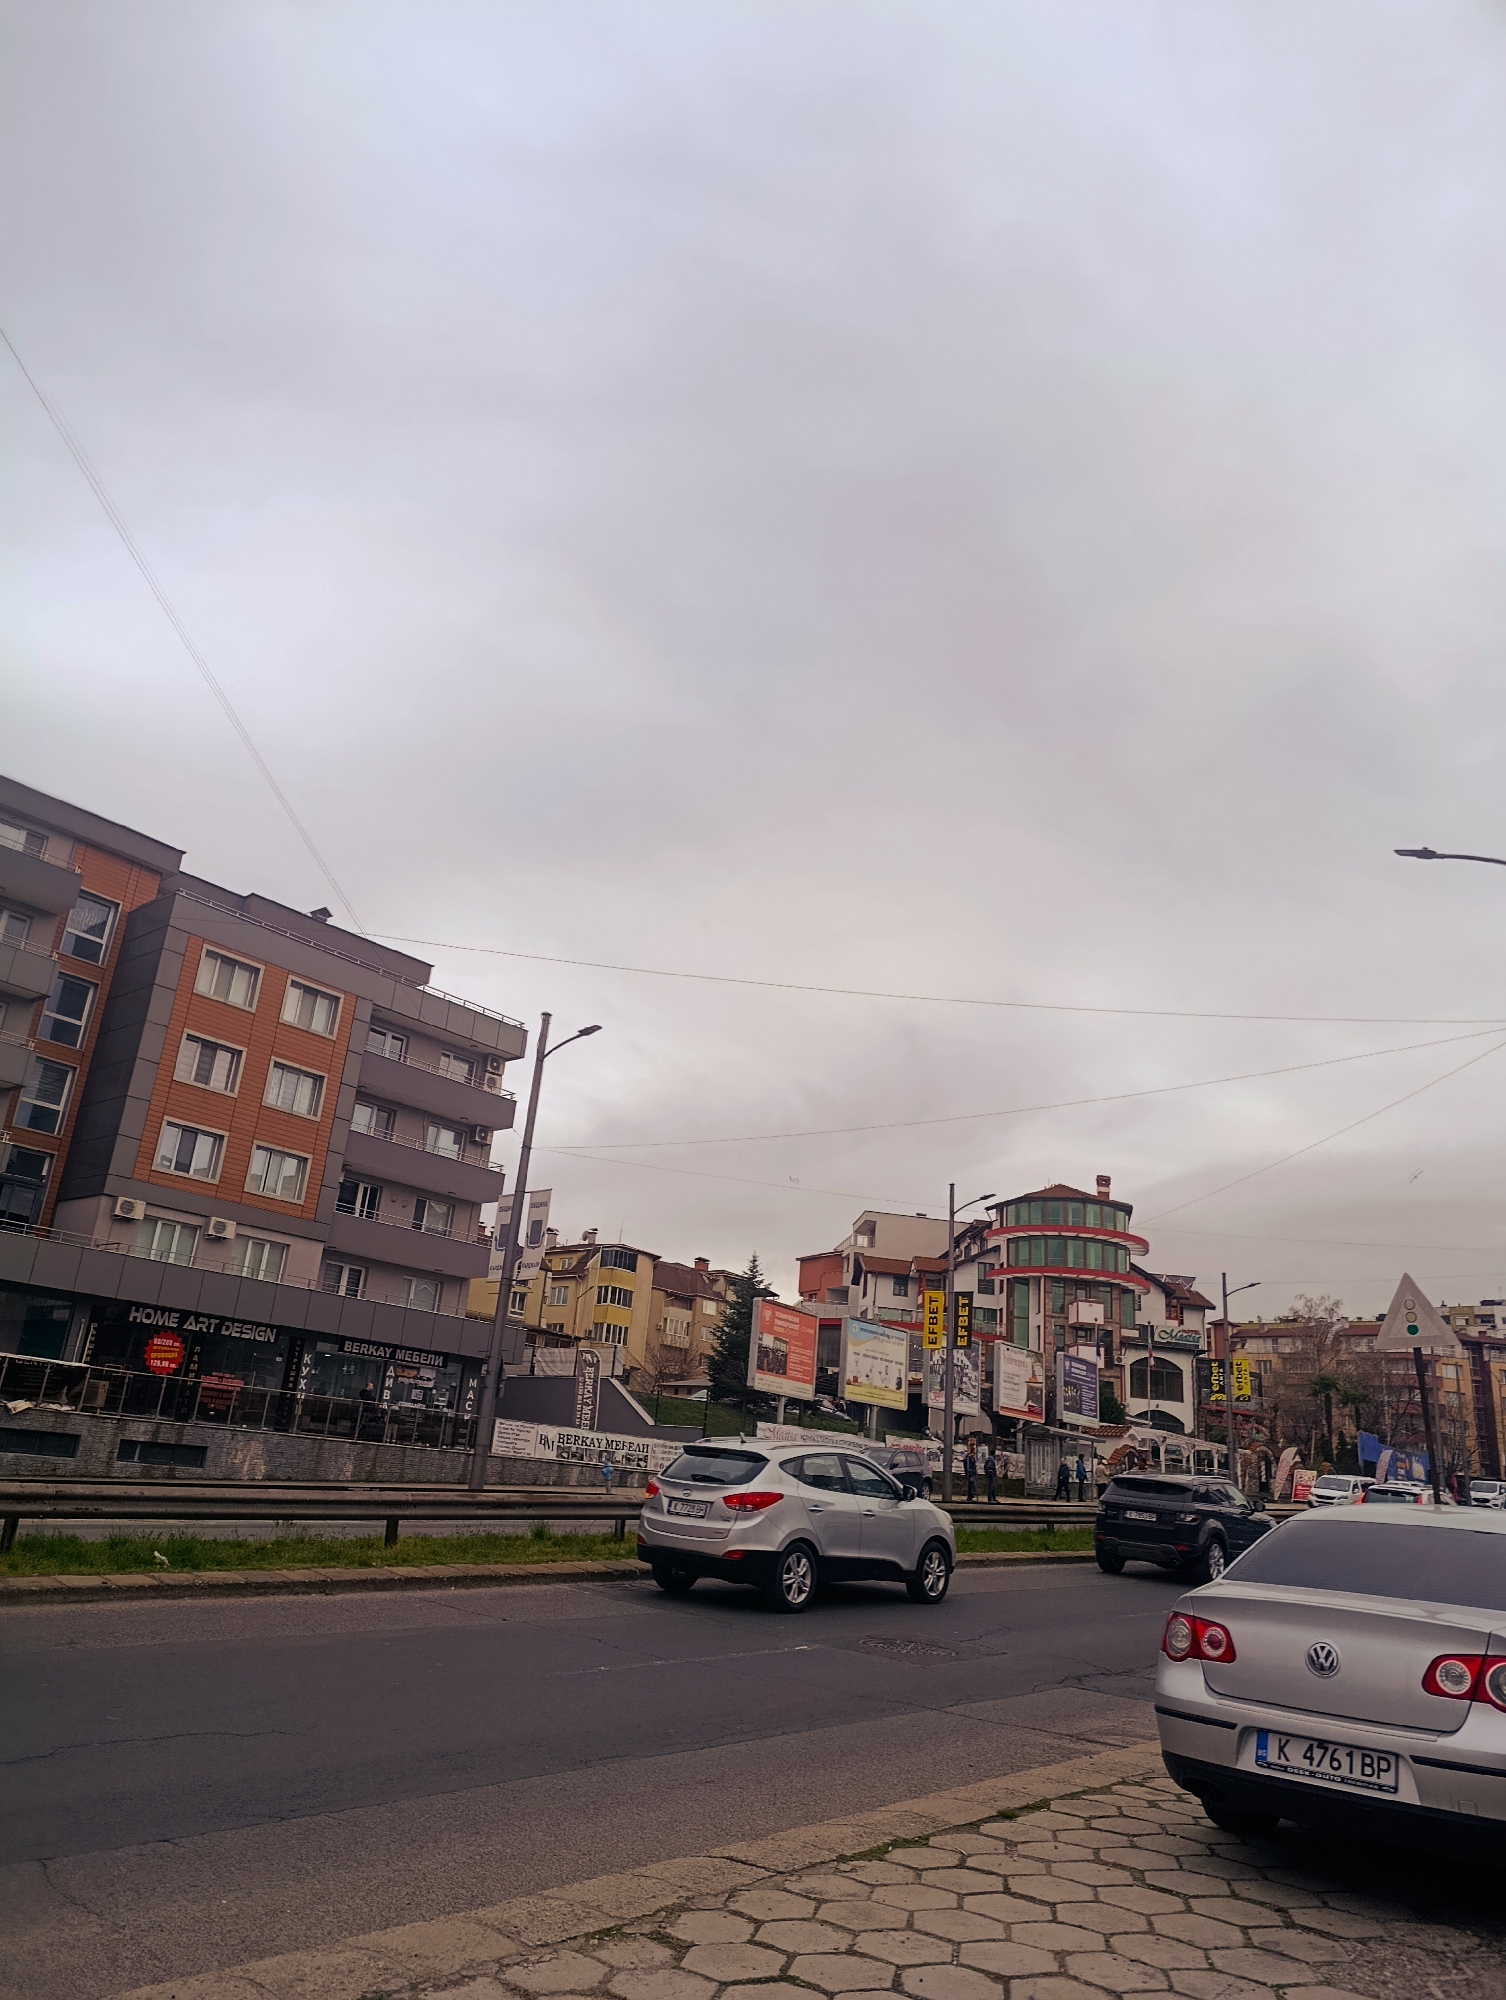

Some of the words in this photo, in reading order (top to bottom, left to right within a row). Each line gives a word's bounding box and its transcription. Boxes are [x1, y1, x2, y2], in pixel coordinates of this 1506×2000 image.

[128, 1306, 181, 1328] HOME
[183, 1315, 220, 1333] ART
[221, 1321, 277, 1343] DESIGN
[928, 1296, 939, 1345] EFBET
[957, 1296, 969, 1346] EFBET
[343, 1340, 393, 1358] BERKAY
[395, 1349, 444, 1367] МЕБЕЛИ
[583, 1367, 595, 1405] BERKAY
[1210, 1361, 1219, 1391] efbet
[1235, 1361, 1243, 1391] efbet
[557, 1433, 603, 1449] BERKAY
[1277, 1737, 1291, 1762] K
